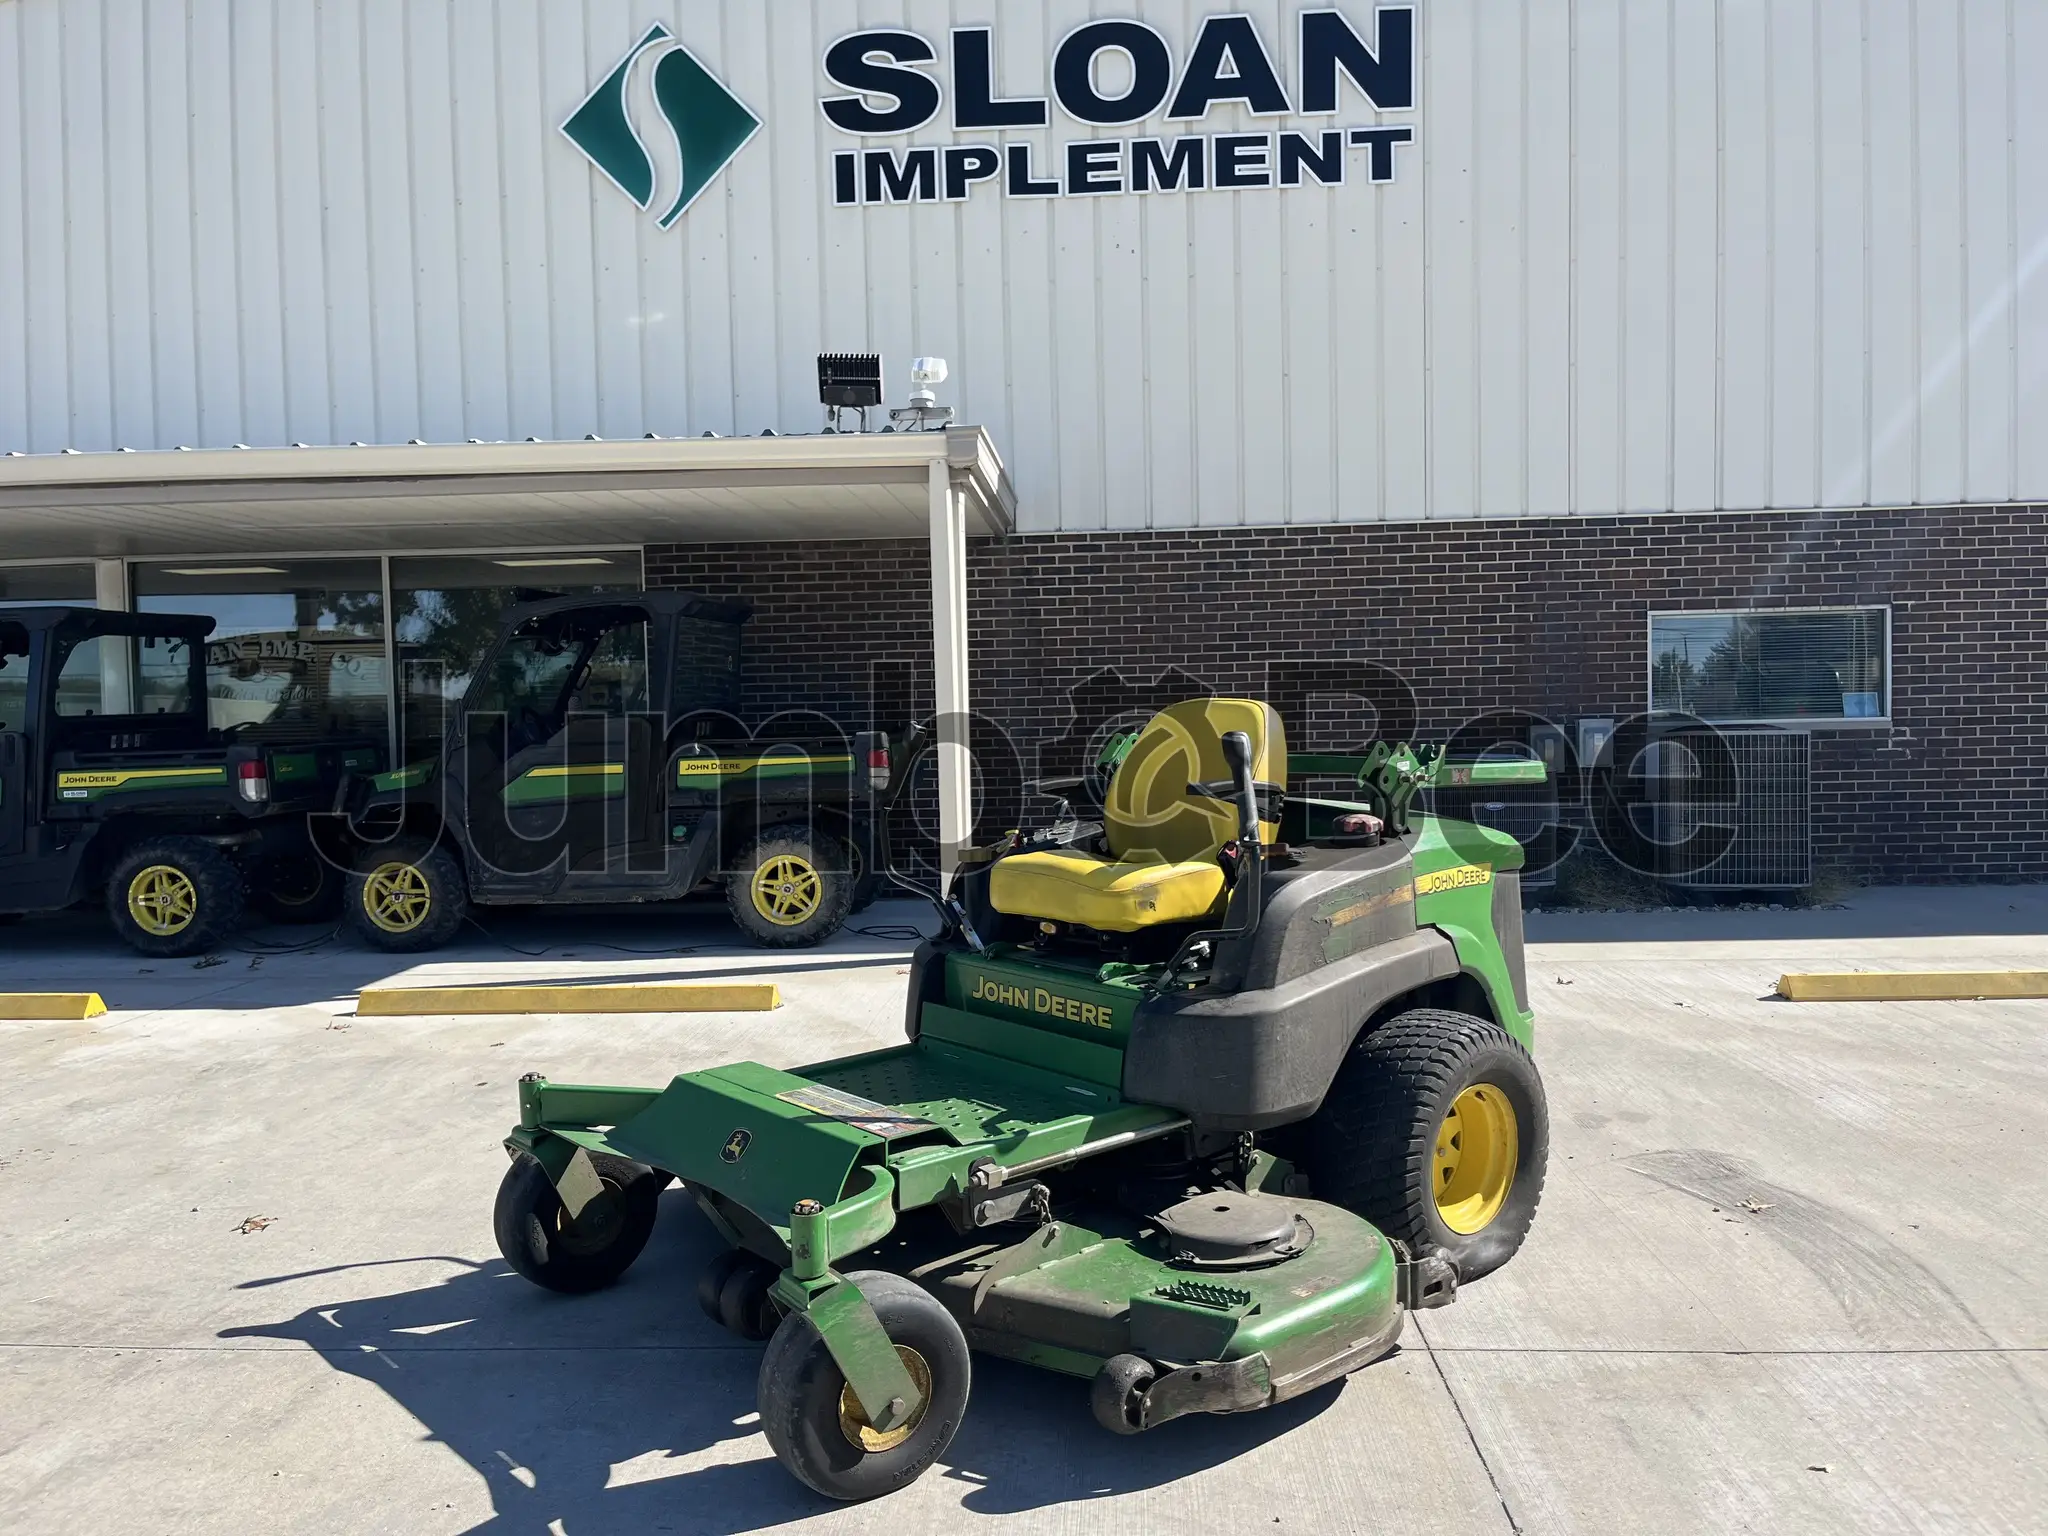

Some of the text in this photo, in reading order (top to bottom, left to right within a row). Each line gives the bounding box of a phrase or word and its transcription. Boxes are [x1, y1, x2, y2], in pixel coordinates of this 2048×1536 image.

[819, 3, 1415, 136] SLOAN
[831, 124, 1414, 206] IMPLEMENT
[64, 775, 117, 784] JOHN DEERE
[685, 762, 741, 771] JOHN DEERE
[1429, 869, 1487, 891] JOHN DEERE
[972, 975, 1113, 1030] JOHN DEERE
